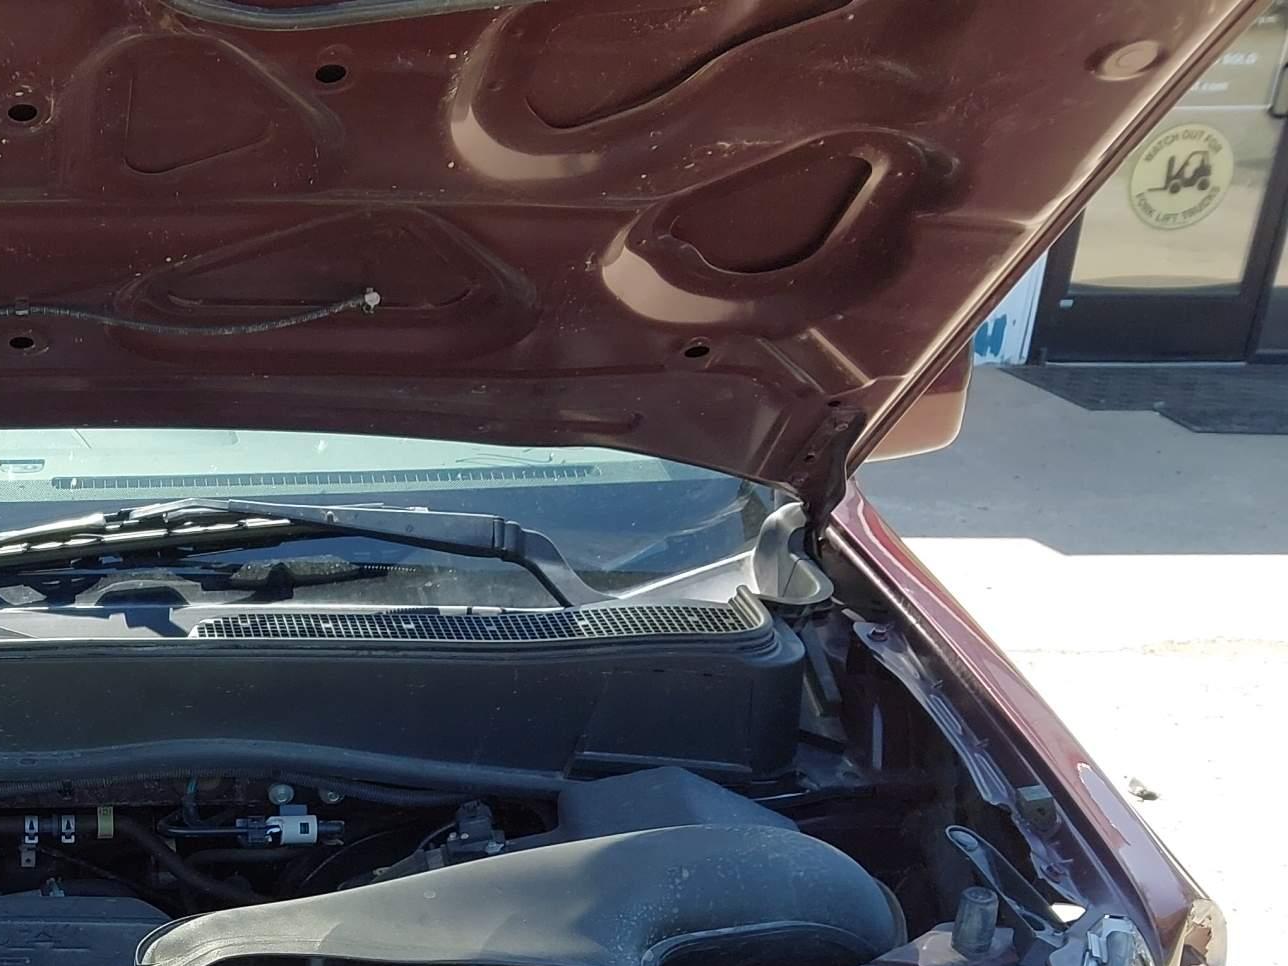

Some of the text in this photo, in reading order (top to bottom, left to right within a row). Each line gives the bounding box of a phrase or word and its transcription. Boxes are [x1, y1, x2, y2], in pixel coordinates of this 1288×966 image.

[1144, 134, 1179, 162] WATCH
[1181, 128, 1206, 141] OUT
[1154, 211, 1180, 224] LIFT
